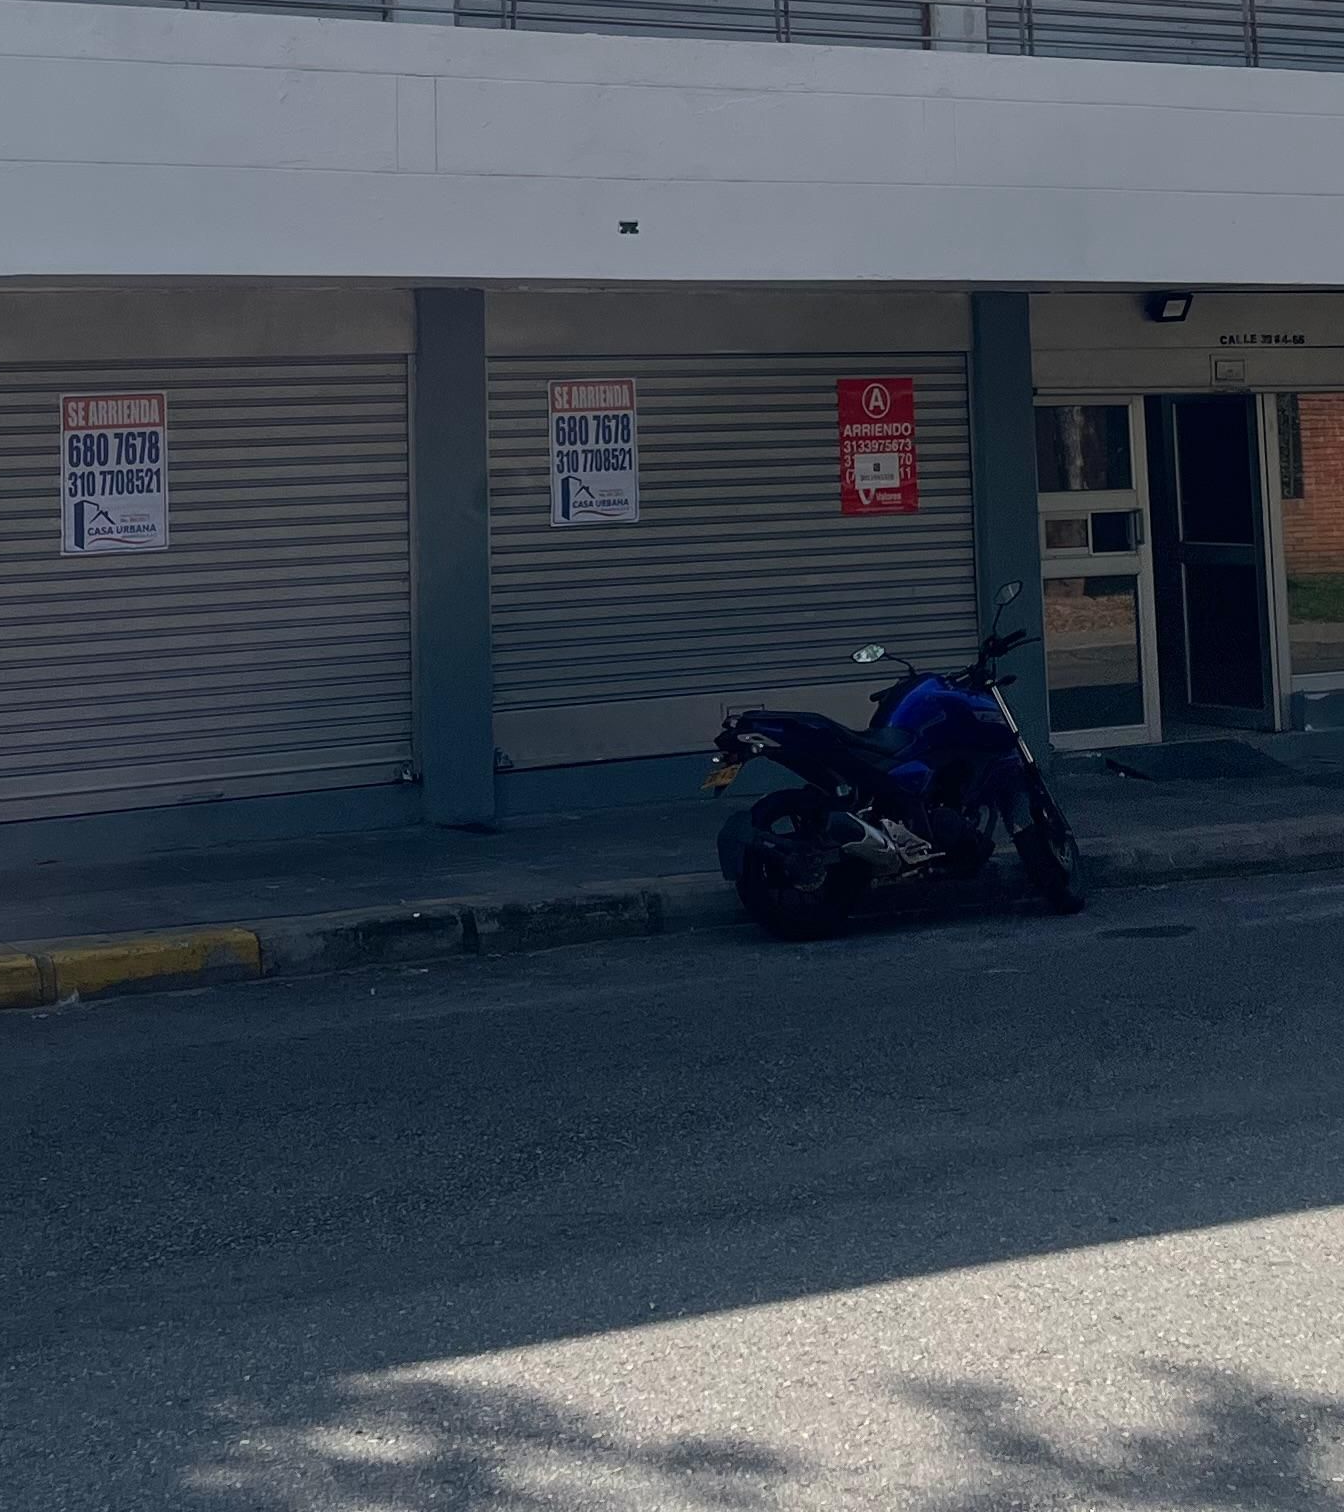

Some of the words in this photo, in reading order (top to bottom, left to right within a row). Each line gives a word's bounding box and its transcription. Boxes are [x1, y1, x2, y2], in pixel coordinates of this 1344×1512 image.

[1219, 334, 1257, 345] CALLE
[554, 386, 570, 409] SE
[571, 385, 630, 409] ARRIENDA
[868, 388, 885, 410] A
[67, 401, 86, 427] SE
[87, 399, 160, 426] ARRIENDA
[555, 415, 589, 446] 680
[592, 413, 631, 445] 7678
[843, 422, 912, 438] ARRIENDO
[67, 432, 109, 468] 680
[113, 430, 160, 466] 7678
[843, 438, 912, 453] 3133975673
[556, 449, 579, 474] 310
[581, 447, 632, 473] 7708521
[68, 470, 96, 498] 310
[99, 467, 161, 496] 7708521
[572, 500, 594, 509] CASA
[87, 526, 114, 536] CASA
[116, 523, 157, 535] URBANA
